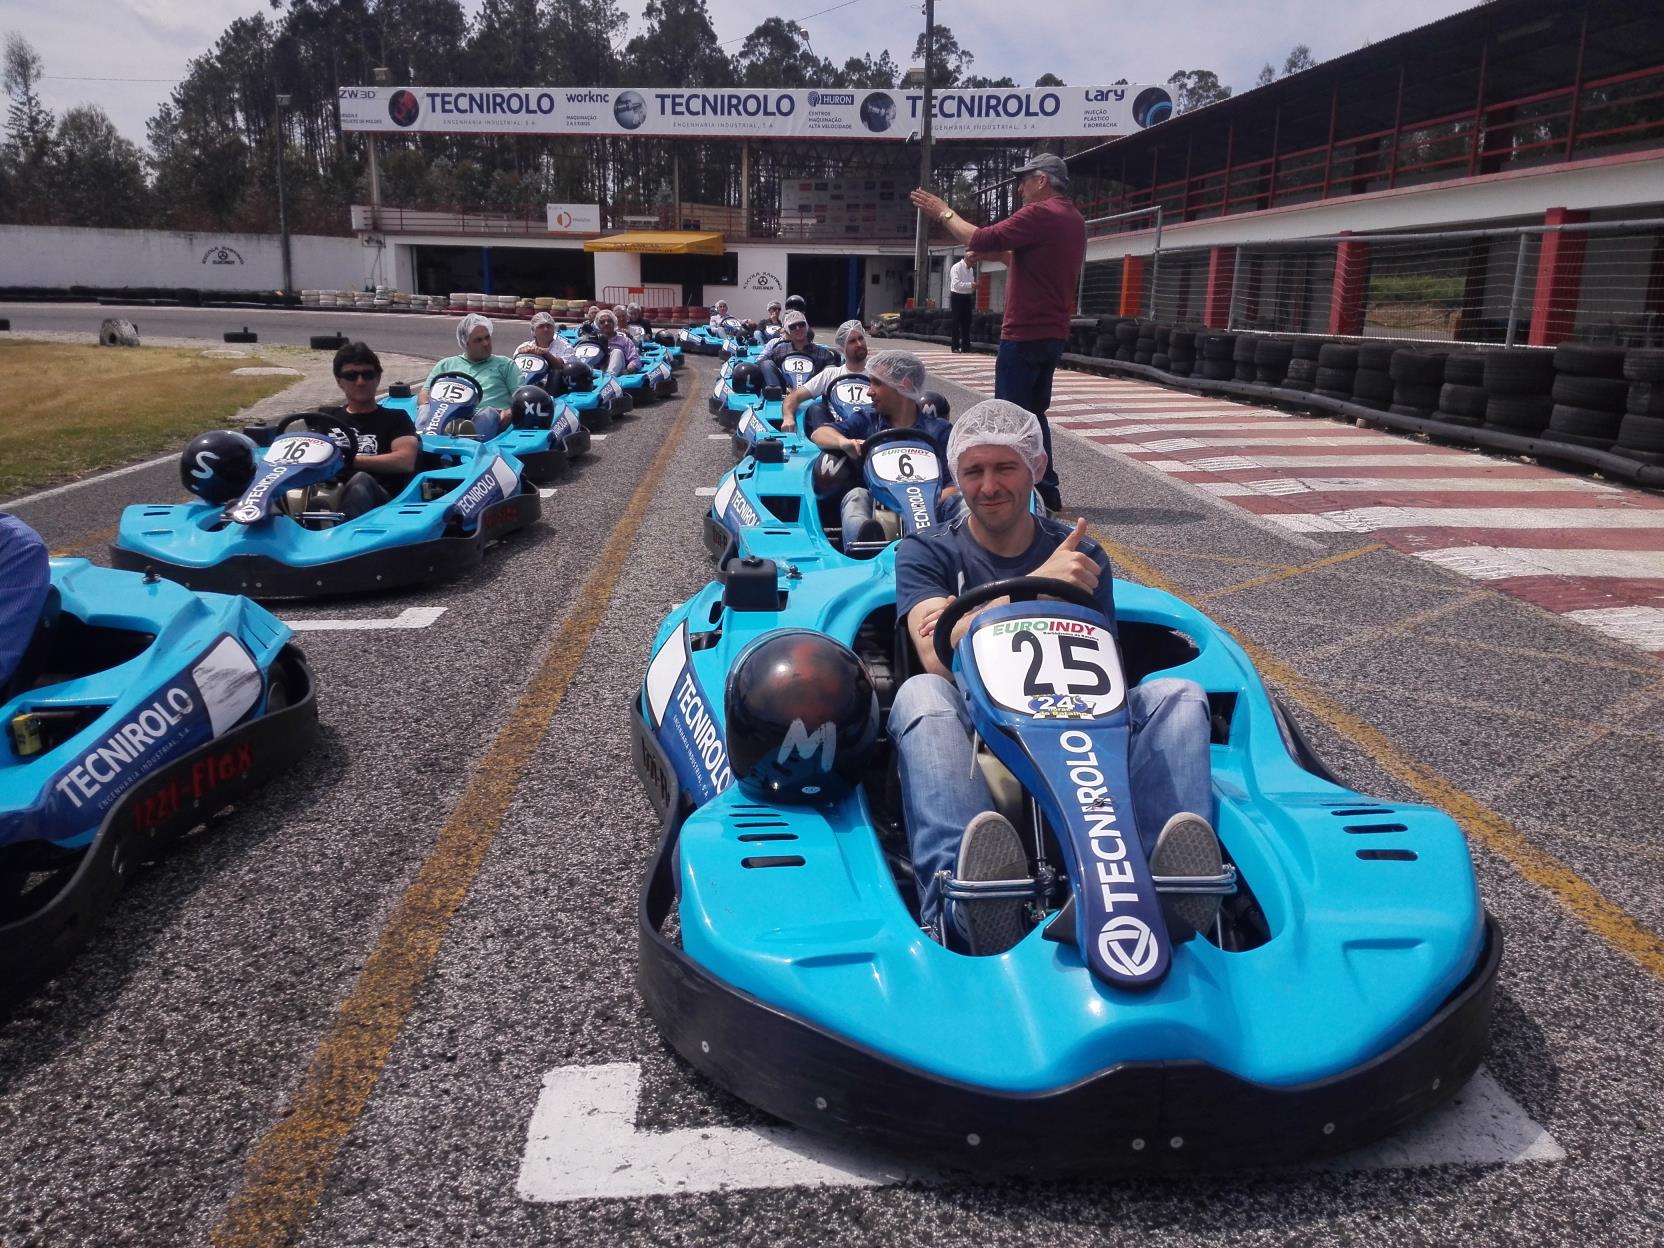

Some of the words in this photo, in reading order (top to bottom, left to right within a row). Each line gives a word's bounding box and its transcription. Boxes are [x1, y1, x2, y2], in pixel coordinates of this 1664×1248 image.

[426, 92, 555, 115] TECNIROLO
[655, 93, 795, 117] TECNIROLO
[823, 95, 852, 105] HURON
[905, 93, 1061, 118] TECNIROLO
[521, 358, 533, 370] 19
[793, 361, 804, 371] 13
[442, 384, 465, 400] 15
[847, 386, 863, 401] 17
[524, 400, 550, 417] XL
[282, 441, 310, 460] 16
[190, 451, 221, 479] S
[898, 453, 915, 478] 6
[457, 473, 496, 517] TECNIROLO
[906, 486, 931, 531] ECNIROLO
[992, 620, 1097, 637] EUROINDY
[1011, 630, 1112, 696] 25
[677, 672, 731, 796] TECNIROLO
[777, 717, 837, 773] M
[55, 686, 194, 808] TECNIROLO
[1060, 729, 1139, 913] TECNIROLO
